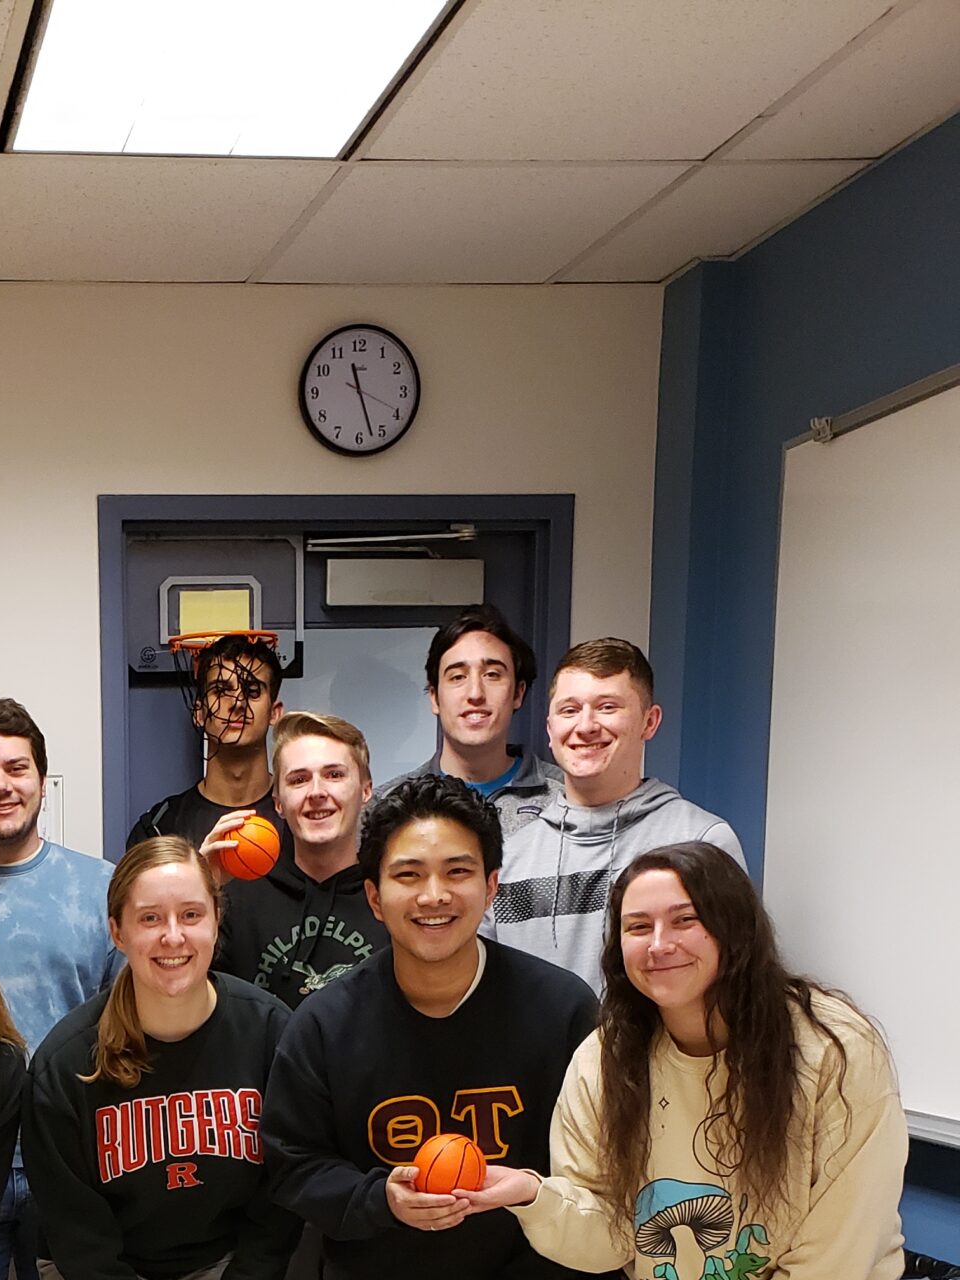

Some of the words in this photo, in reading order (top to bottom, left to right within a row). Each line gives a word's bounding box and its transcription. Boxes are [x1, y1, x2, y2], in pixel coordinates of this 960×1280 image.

[351, 338, 367, 352] 12
[331, 347, 344, 359] 11
[379, 346, 385, 359] 1
[316, 364, 330, 377] 10
[392, 361, 401, 375] 2
[310, 386, 319, 400] 9
[399, 385, 408, 399] 3
[318, 409, 327, 422] 8
[392, 408, 400, 421] 4
[334, 426, 342, 439] 7
[355, 431, 363, 445] 6
[378, 425, 386, 438] 5
[95, 1088, 264, 1184] RUTGERS
[165, 1162, 200, 1190] R
